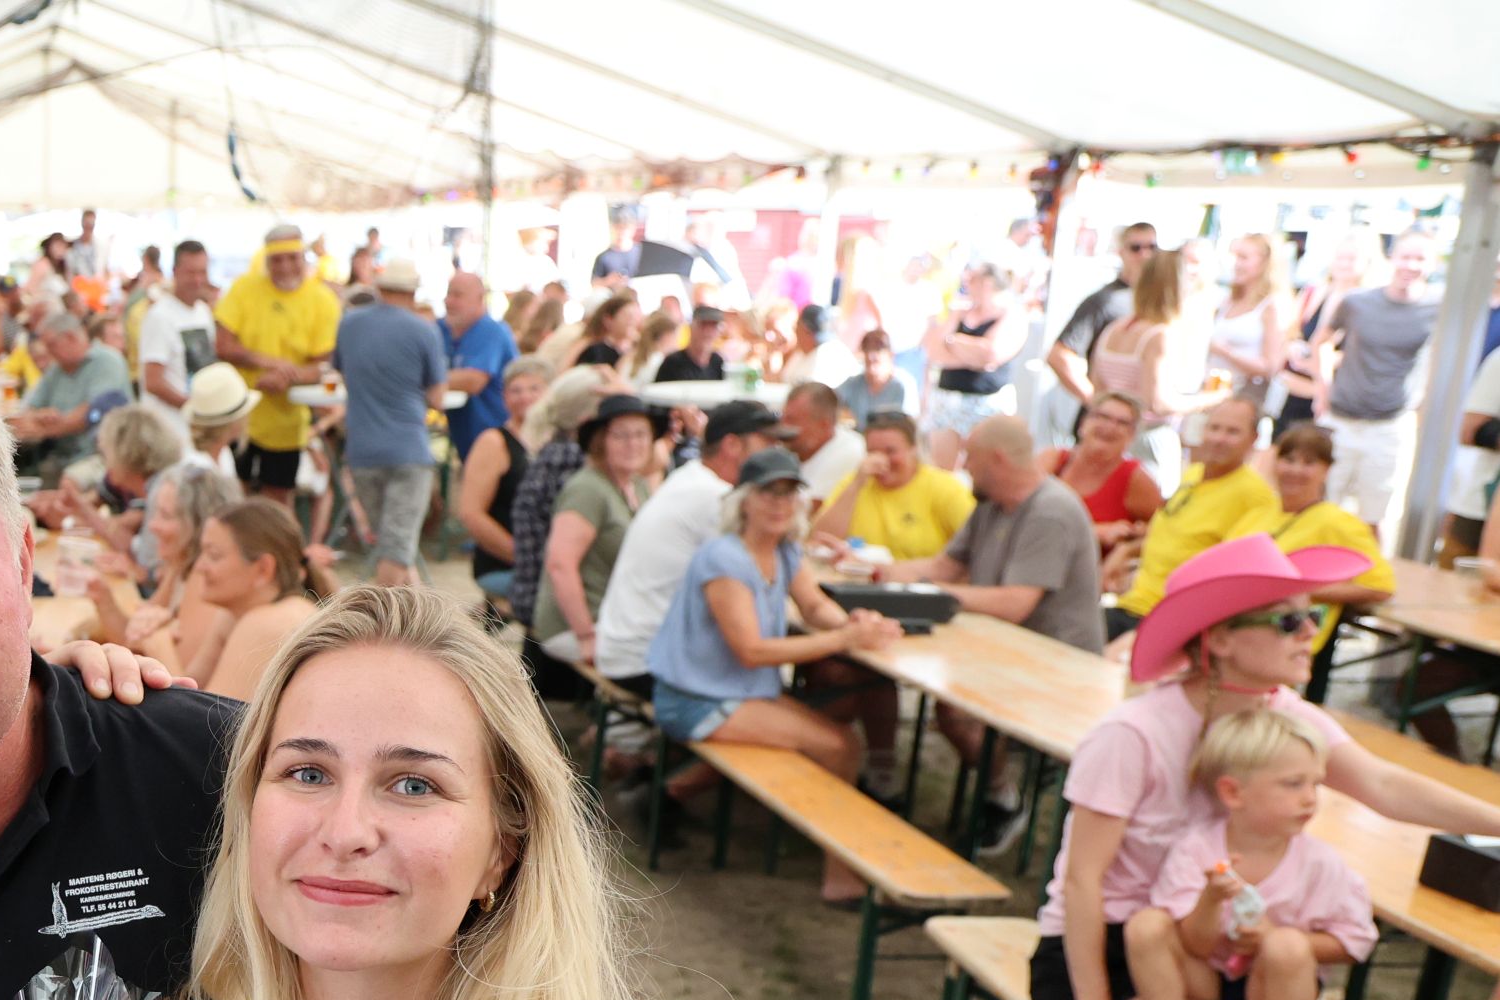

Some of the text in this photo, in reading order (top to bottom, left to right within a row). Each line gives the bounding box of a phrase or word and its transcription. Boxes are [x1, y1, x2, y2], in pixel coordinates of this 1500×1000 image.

[68, 874, 105, 886] MARTENS
[105, 869, 136, 880] RØGERI
[65, 878, 150, 896] FROKOSTRESTAURANT
[81, 905, 97, 914] TLF.
[98, 903, 106, 911] 55
[107, 902, 117, 910] 44
[118, 900, 126, 909] 21
